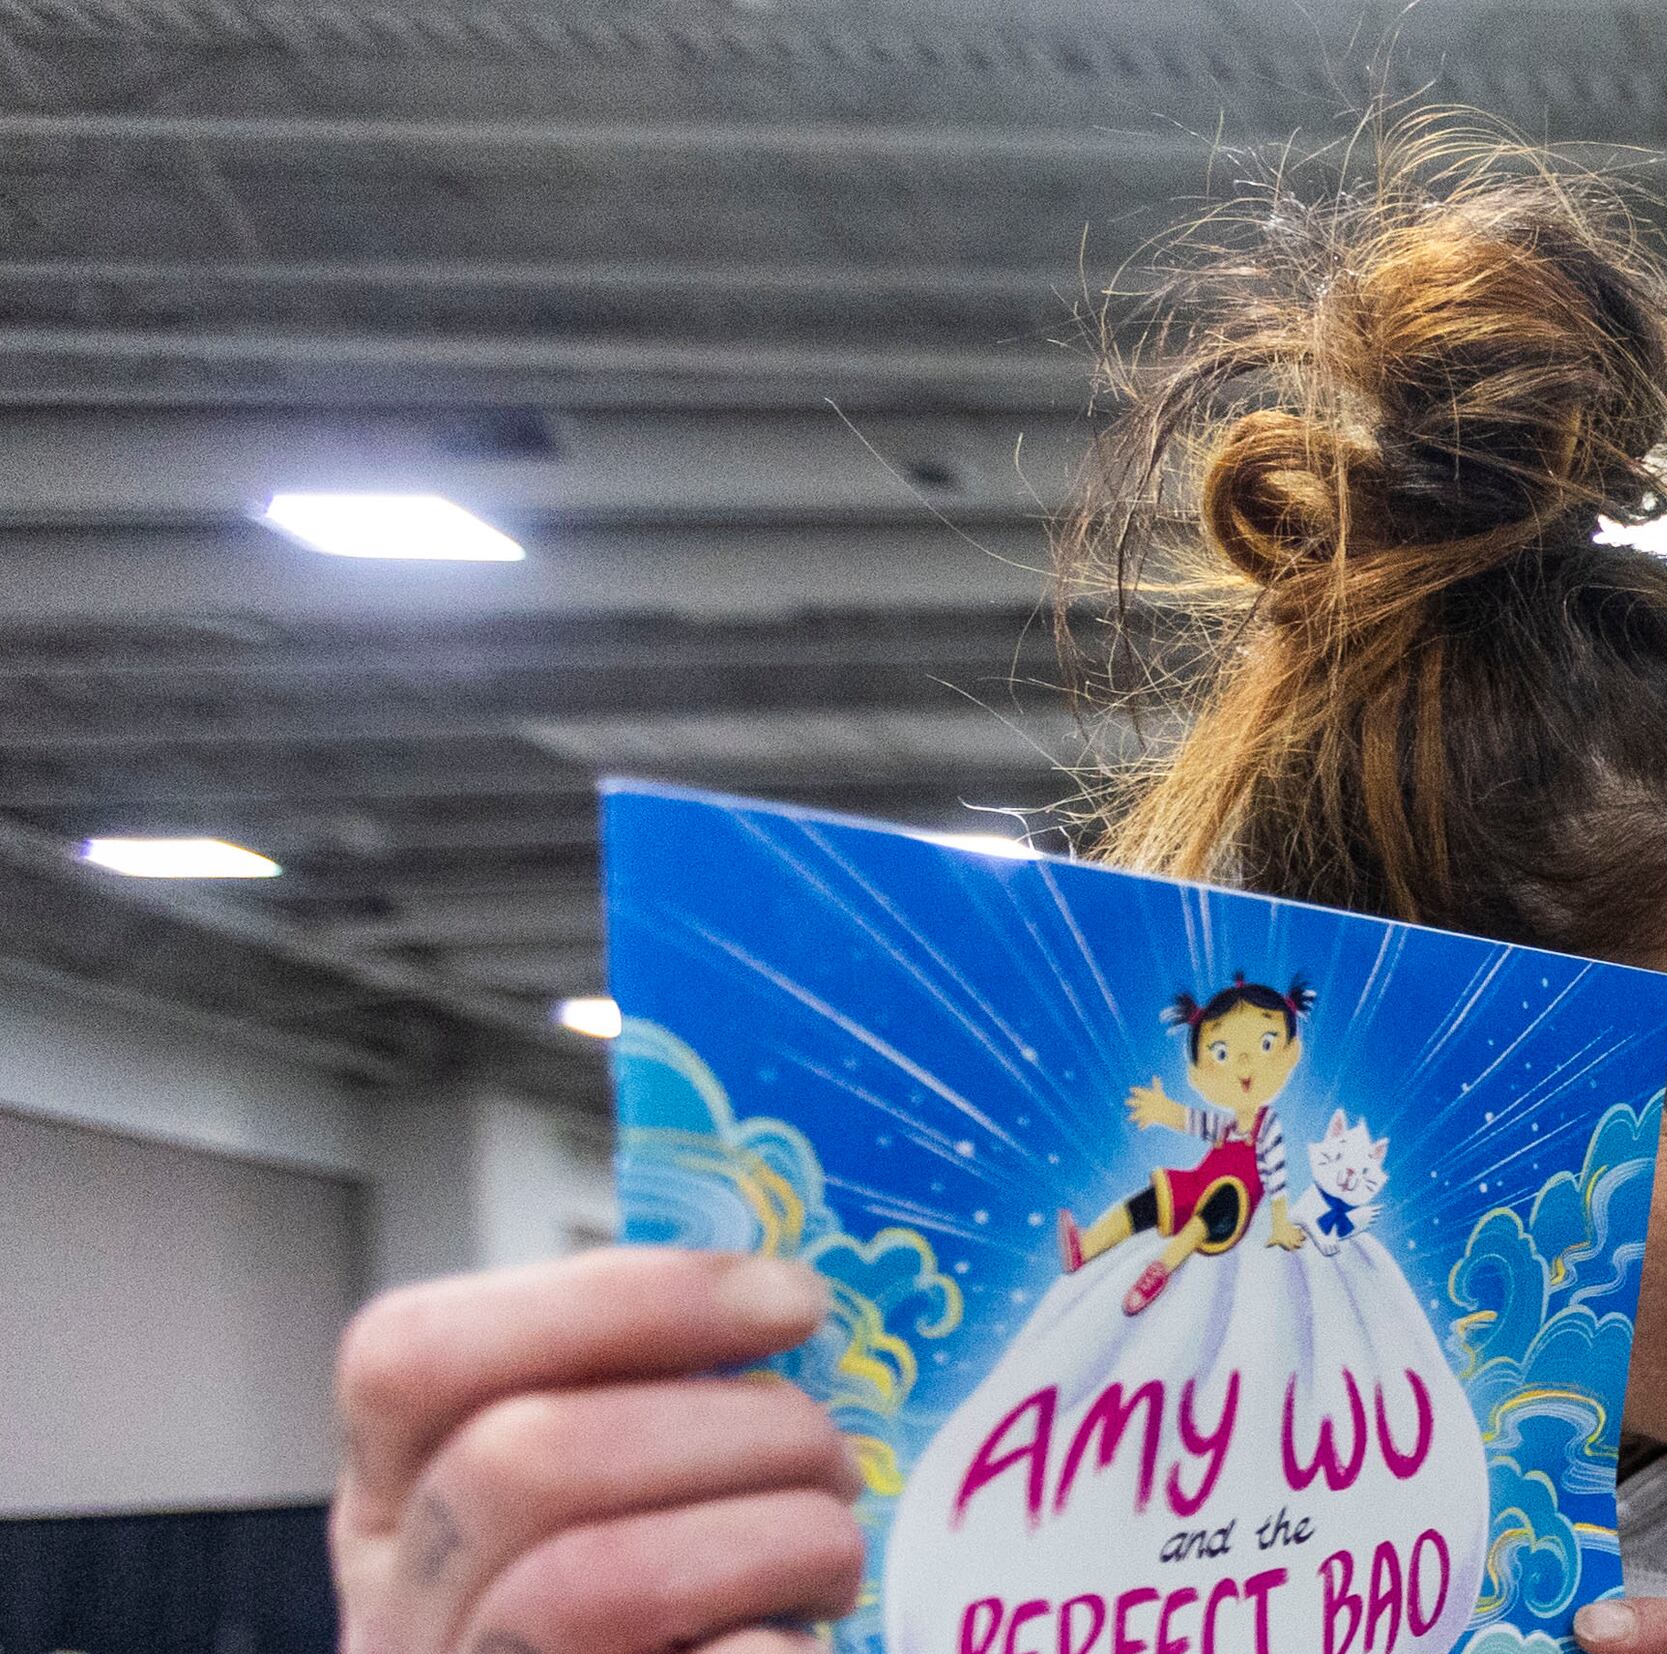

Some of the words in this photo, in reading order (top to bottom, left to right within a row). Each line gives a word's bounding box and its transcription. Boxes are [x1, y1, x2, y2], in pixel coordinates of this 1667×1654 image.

[949, 1368, 1241, 1532] AMY
[1282, 1364, 1434, 1491] WU
[1159, 1519, 1236, 1563] and
[1255, 1507, 1316, 1551] the
